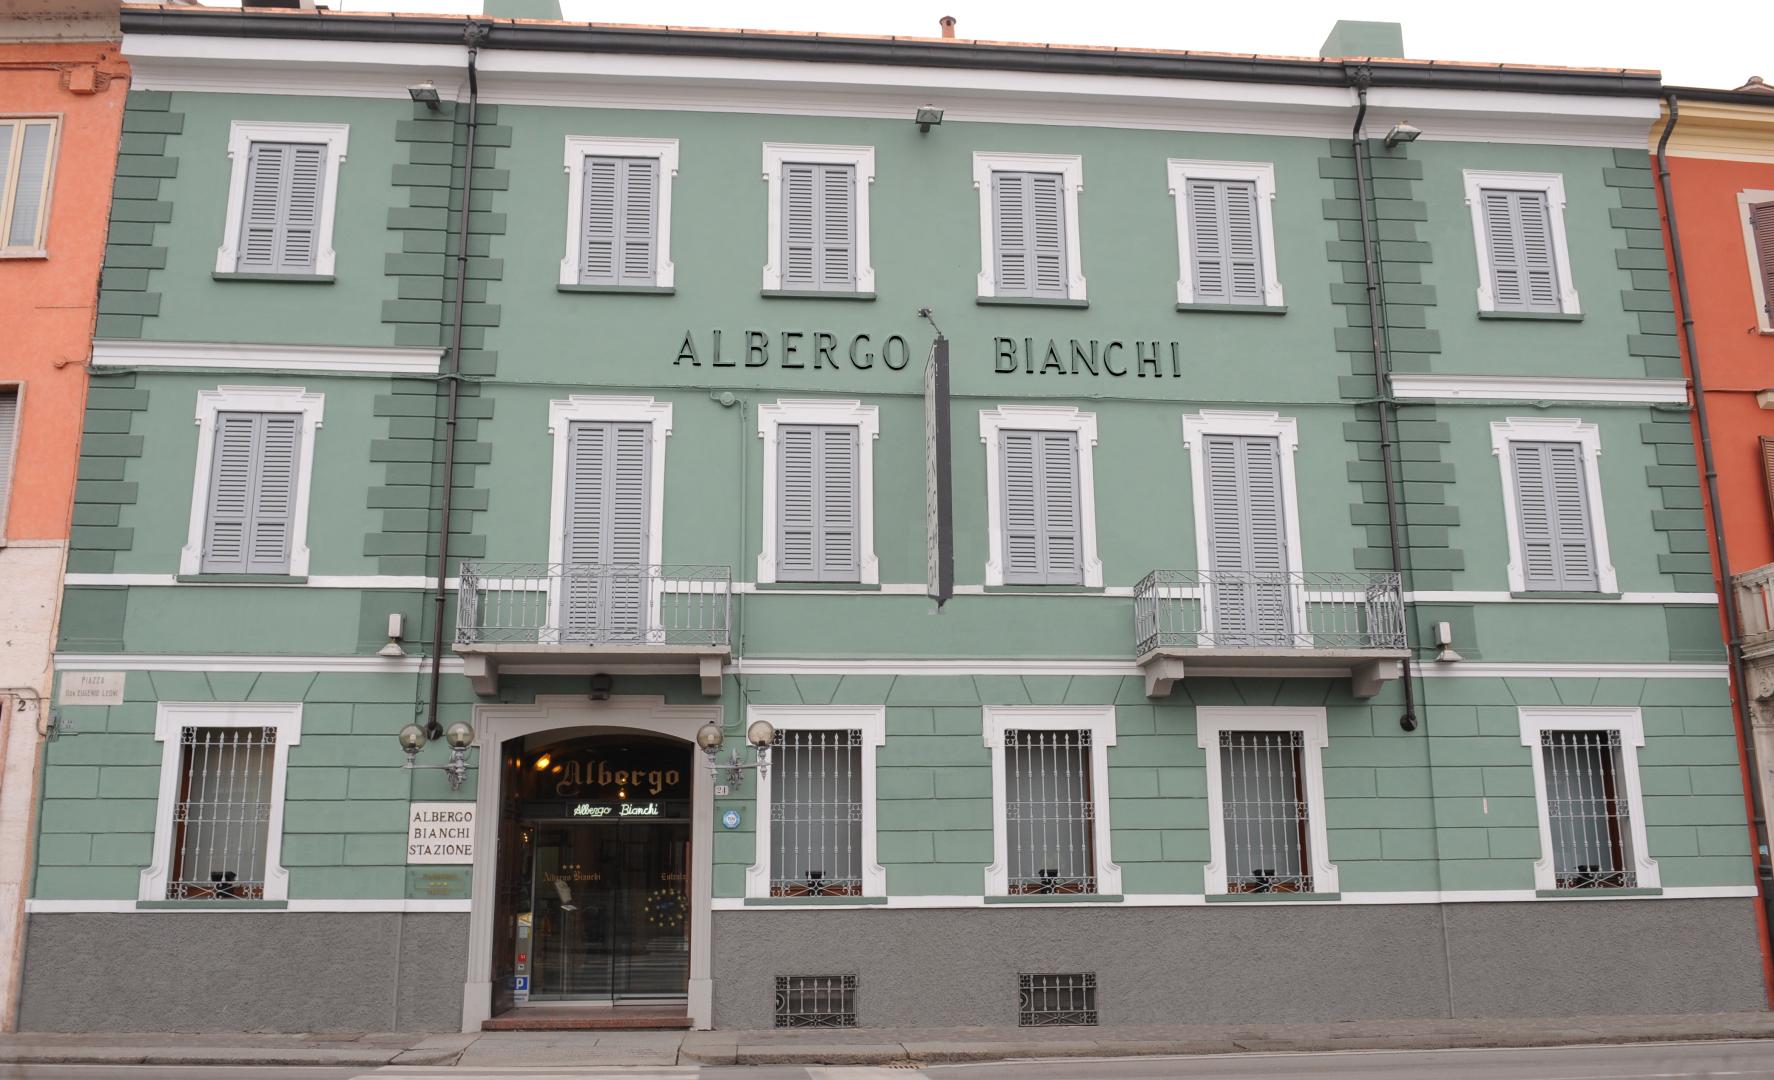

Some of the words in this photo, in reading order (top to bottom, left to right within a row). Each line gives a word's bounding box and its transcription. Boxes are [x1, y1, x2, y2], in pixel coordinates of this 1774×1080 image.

[673, 329, 911, 370] ALBERGO
[994, 336, 1182, 378] BIANCHI
[81, 676, 104, 685] PIAZZA
[556, 760, 680, 796] Albergo
[573, 804, 612, 817] Albergo
[619, 803, 658, 816] Bianchi
[413, 811, 473, 823] ALBERGO
[414, 828, 470, 839] BIANCHI
[409, 844, 473, 855] STAZIONE
